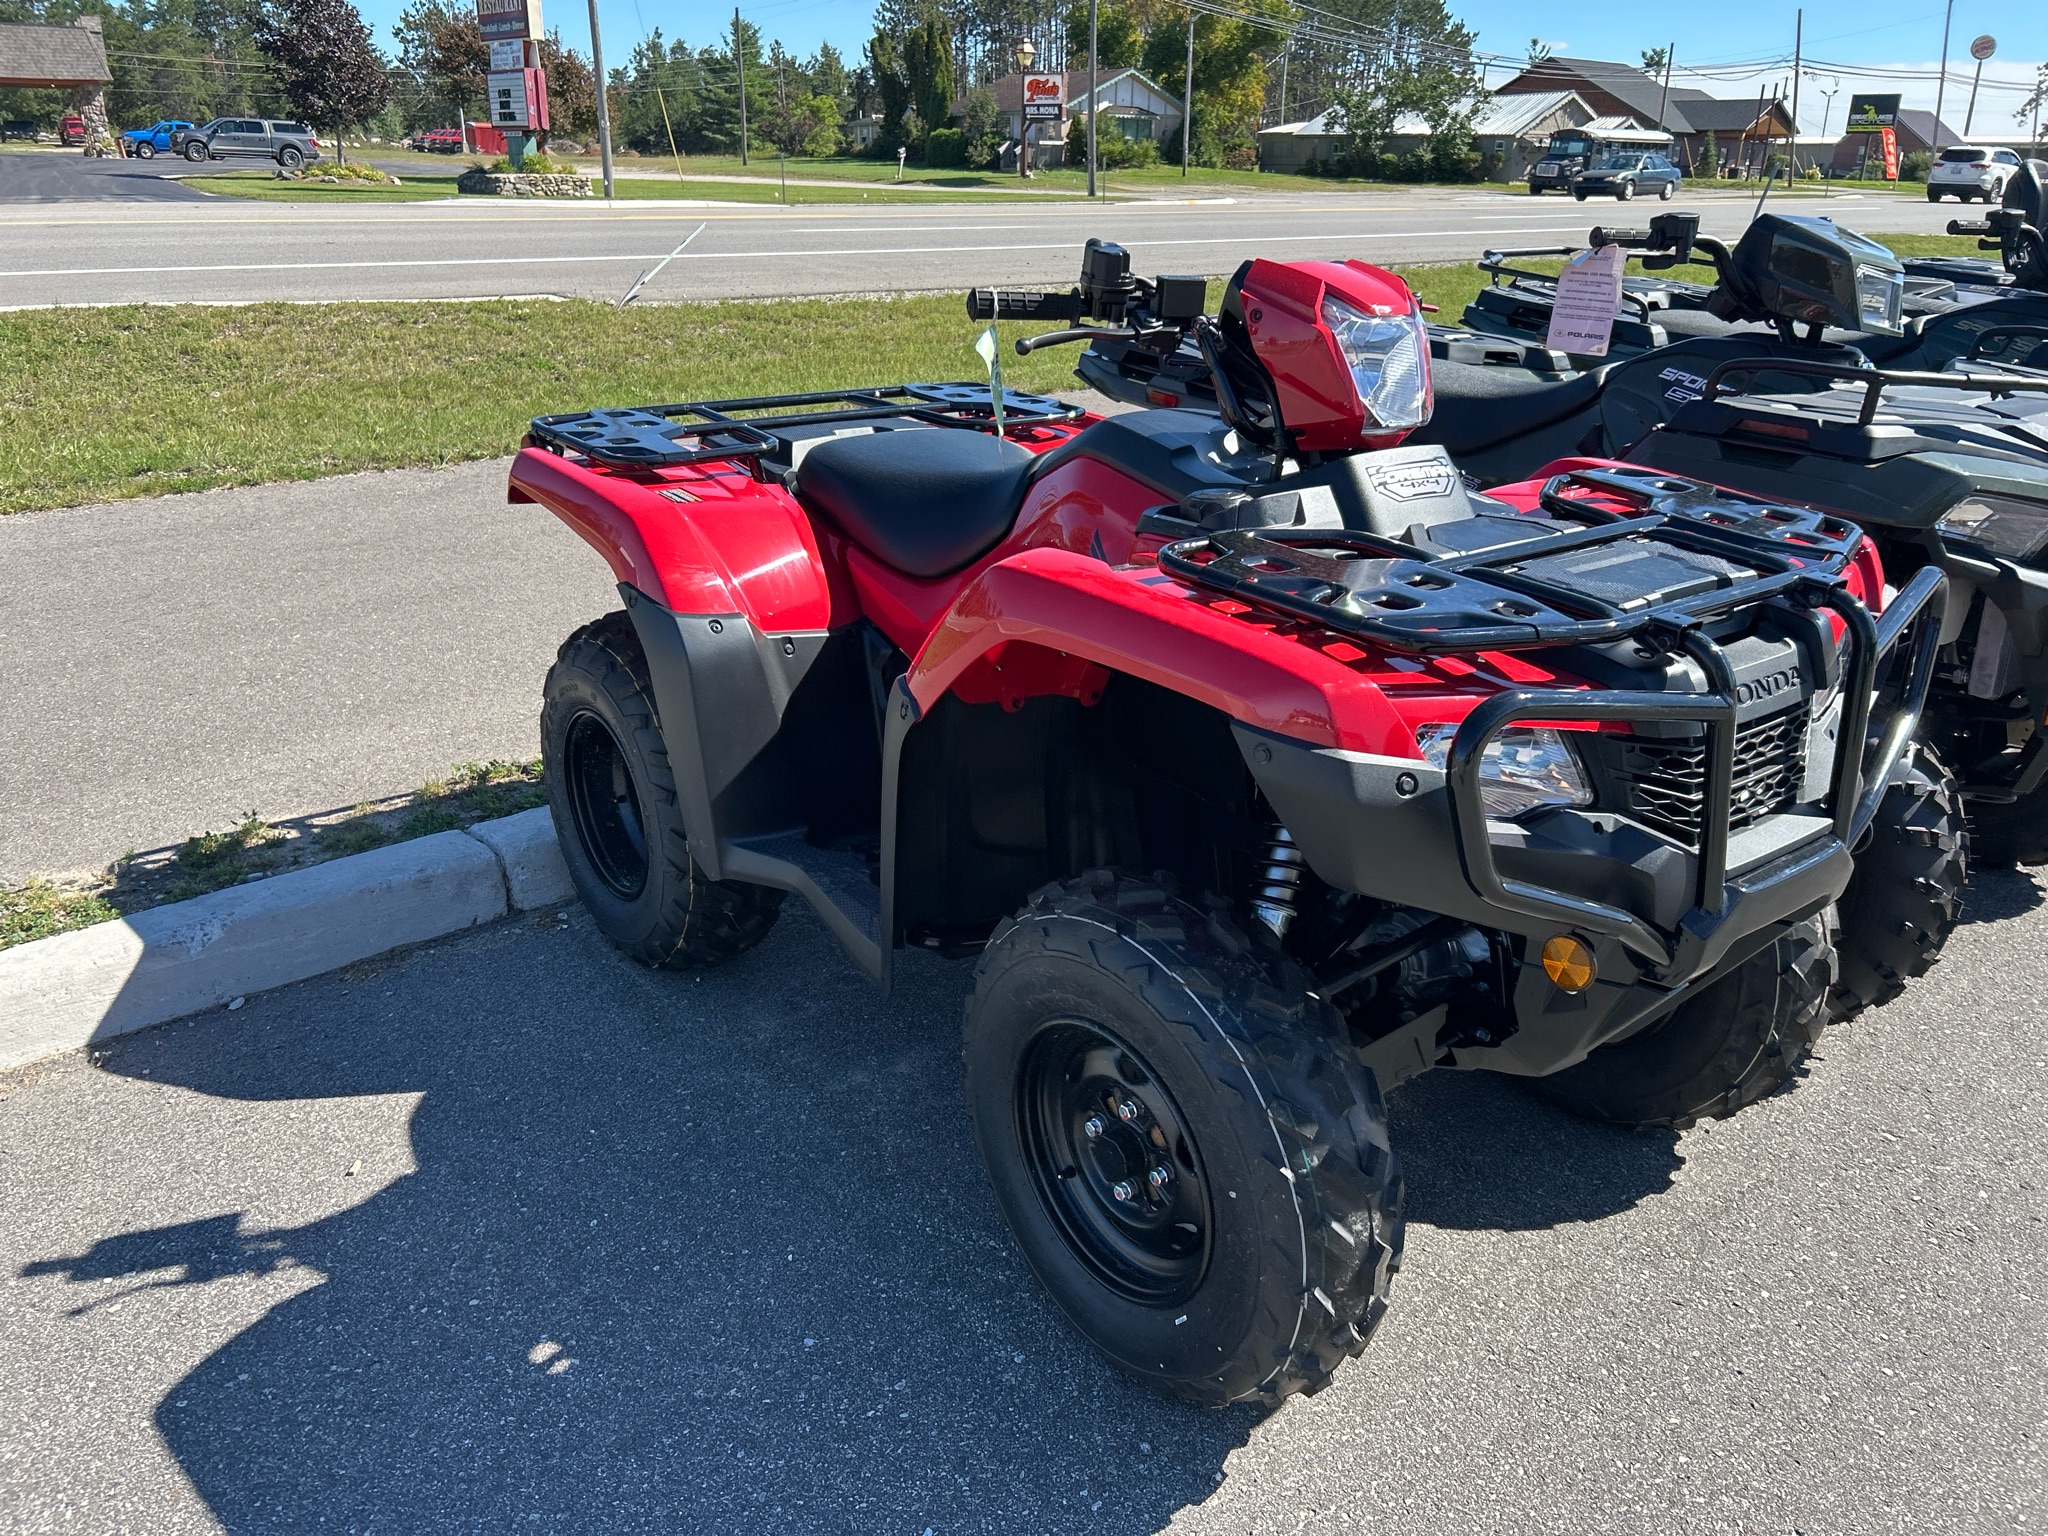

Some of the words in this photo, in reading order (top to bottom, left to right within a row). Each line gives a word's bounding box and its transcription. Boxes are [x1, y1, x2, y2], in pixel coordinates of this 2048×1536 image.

[479, 0, 523, 14] RESTAURANT
[1039, 106, 1059, 115] MONA
[1567, 331, 1605, 341] POLARIS
[1736, 665, 1807, 707] ONDA
